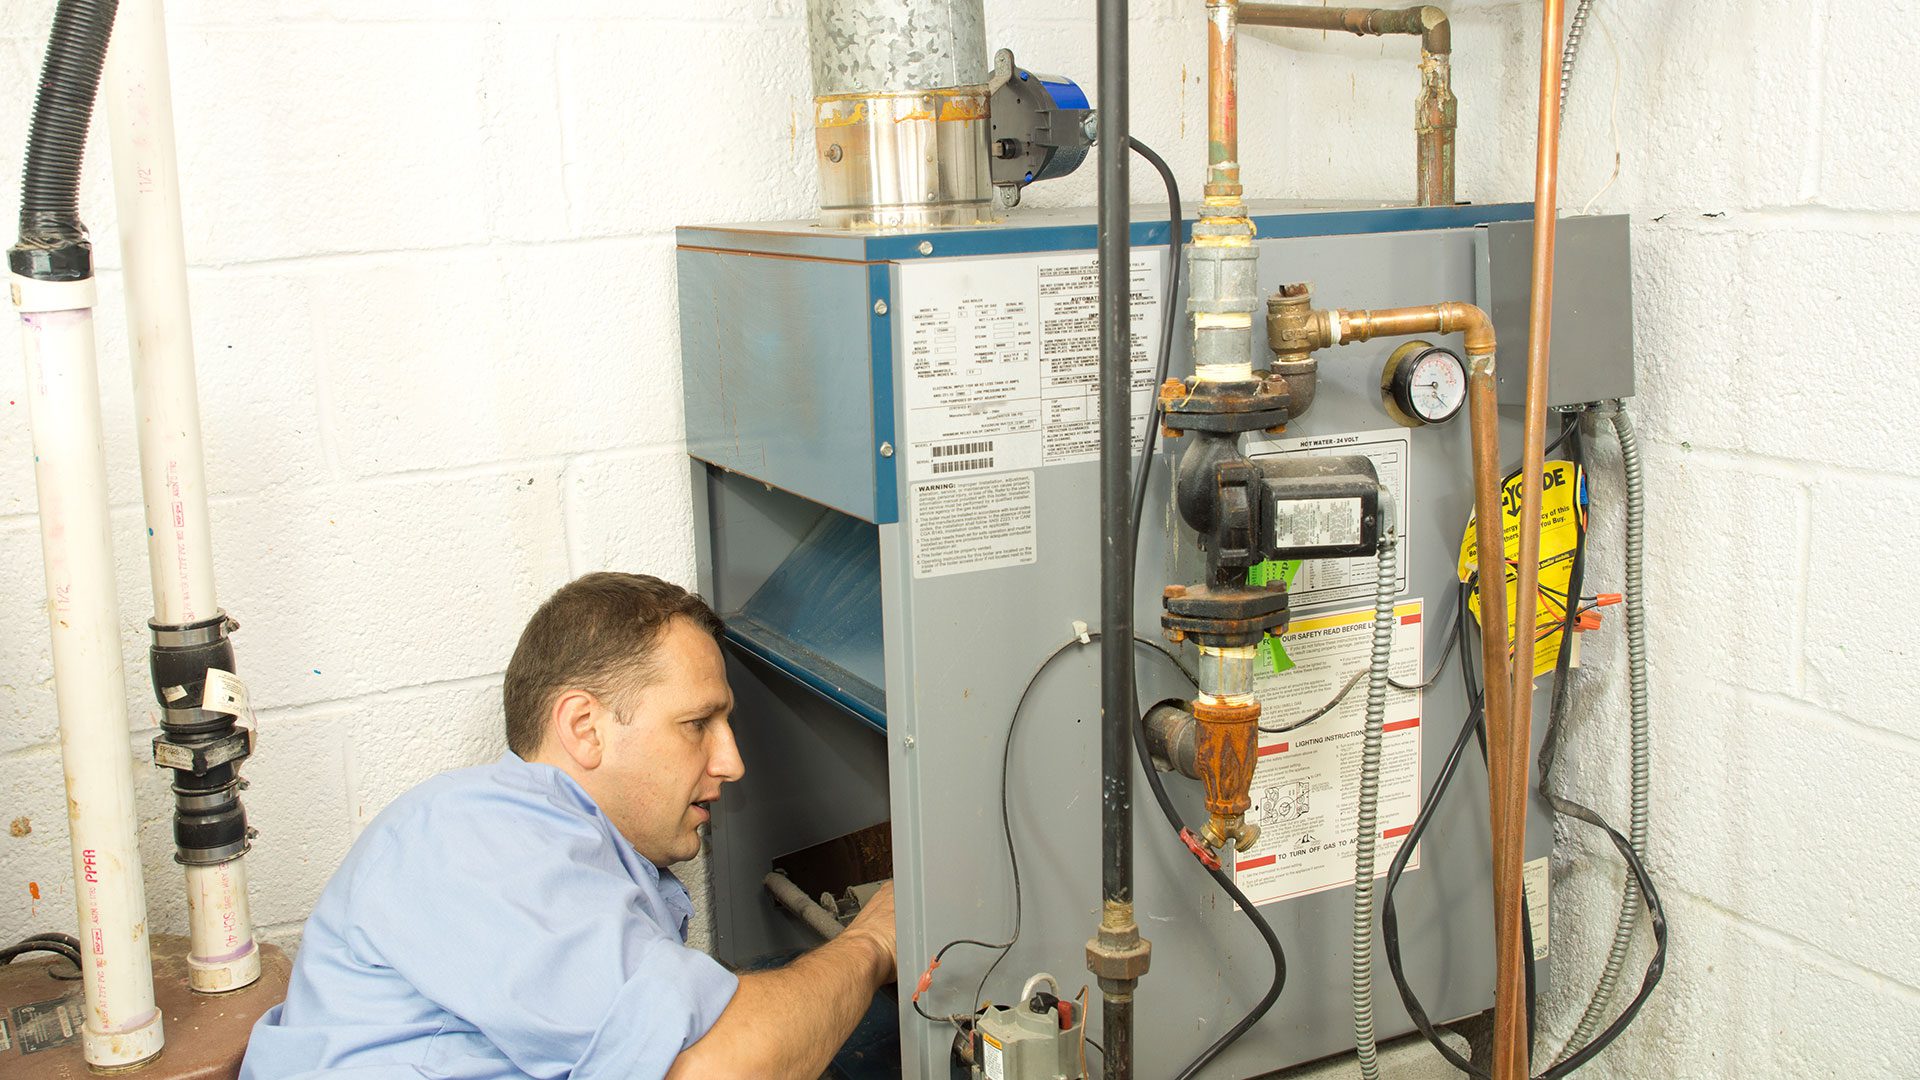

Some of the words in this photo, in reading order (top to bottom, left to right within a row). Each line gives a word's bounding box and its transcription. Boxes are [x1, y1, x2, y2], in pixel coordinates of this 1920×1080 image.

[1313, 438, 1333, 446] WATER
[918, 483, 956, 492] WARNING:
[1557, 505, 1570, 514] this
[1552, 517, 1566, 525] Buy.
[1503, 524, 1518, 534] nergy
[1282, 634, 1297, 643] OUR
[1297, 631, 1322, 642] SAFETY
[1323, 628, 1341, 637] READ
[1342, 625, 1367, 634] BEFORE
[1295, 737, 1323, 748] LIGHTING
[1324, 730, 1364, 742] INSTRUCTION
[1290, 850, 1306, 858] TURN
[1309, 846, 1321, 854] OFF
[83, 849, 98, 883] PPFA
[223, 911, 237, 932] SCH
[225, 935, 238, 948] 40
